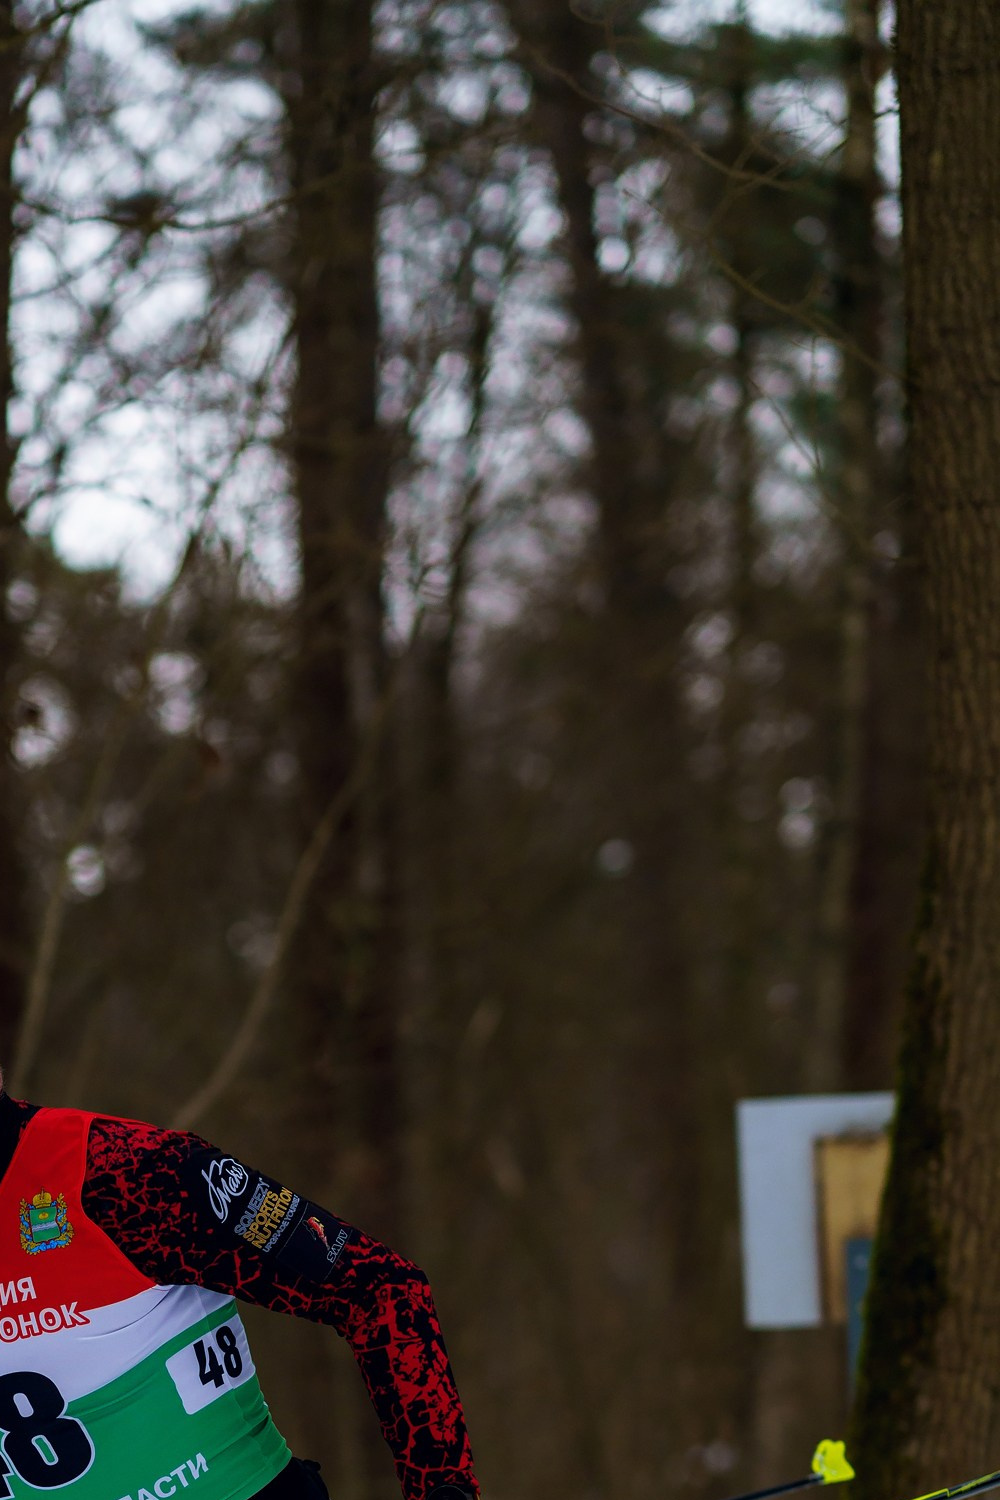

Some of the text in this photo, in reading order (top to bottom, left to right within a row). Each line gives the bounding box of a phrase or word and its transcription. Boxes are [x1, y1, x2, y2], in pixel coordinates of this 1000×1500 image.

[234, 1177, 270, 1236] SQUEEZY
[243, 1190, 279, 1243] SPORTS
[252, 1187, 294, 1249] NUTRITION
[193, 1326, 243, 1388] 48
